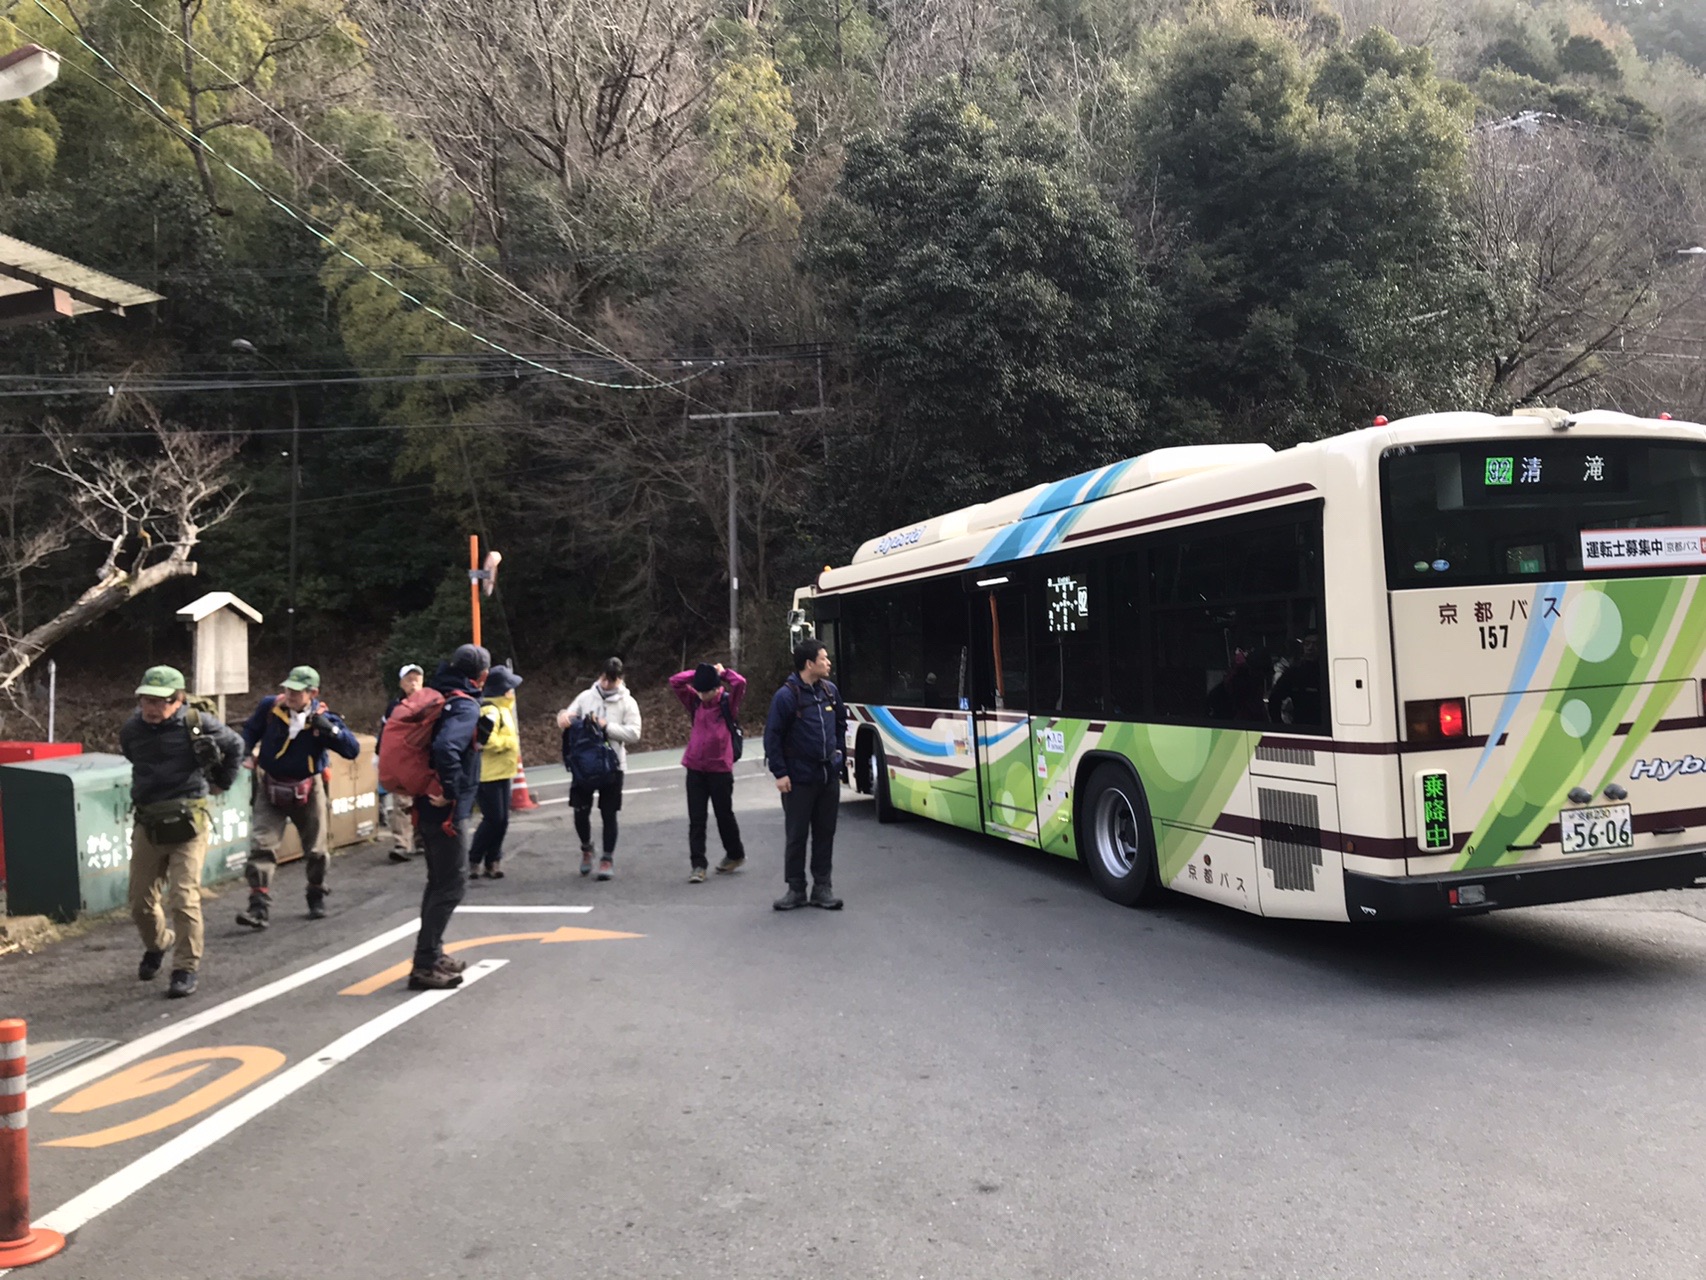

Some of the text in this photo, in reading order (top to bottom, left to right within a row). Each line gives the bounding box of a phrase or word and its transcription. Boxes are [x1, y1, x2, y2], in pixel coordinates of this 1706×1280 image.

[1489, 460, 1510, 483] 92
[1586, 539, 1663, 559] 運転士募集中
[1666, 541, 1698, 552] 京都バス
[1438, 598, 1561, 625] 京都バス
[1479, 625, 1508, 650] 157
[1424, 774, 1448, 848] 乗降中
[1187, 863, 1246, 893] 京都バス
